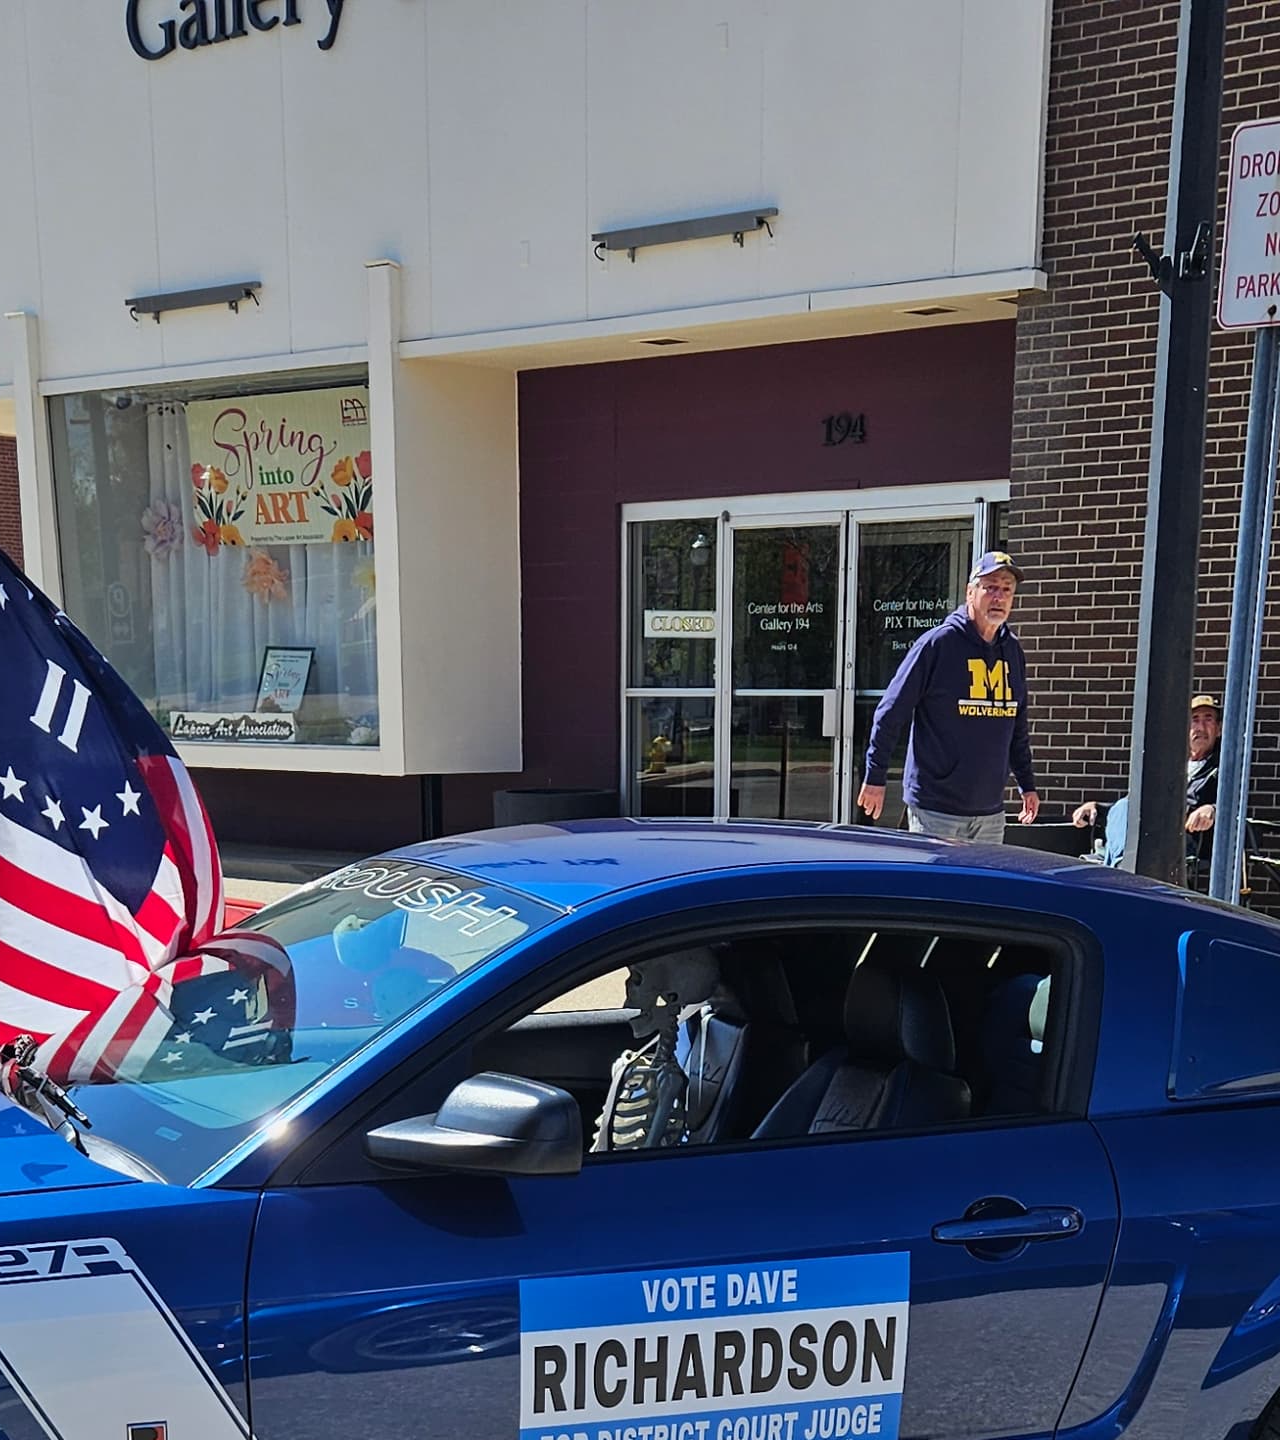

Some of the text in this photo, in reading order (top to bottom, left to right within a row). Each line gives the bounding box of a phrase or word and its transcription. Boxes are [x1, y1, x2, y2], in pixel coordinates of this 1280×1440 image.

[821, 412, 866, 446] 194
[212, 408, 337, 490] Spring
[259, 465, 294, 486] into
[255, 491, 310, 525] ART
[747, 601, 824, 614] Center for the Arts
[873, 598, 953, 611] Center for the Arts
[651, 616, 716, 632] CLOSED
[760, 618, 810, 633] Gallery 194
[885, 616, 903, 629] PIX
[968, 659, 1012, 700] M
[175, 715, 291, 737] Lapeer Art Association
[642, 1269, 798, 1312] VOTE DAVE
[532, 1316, 897, 1414] RICHARDSON
[804, 1403, 883, 1440] JUDGE
